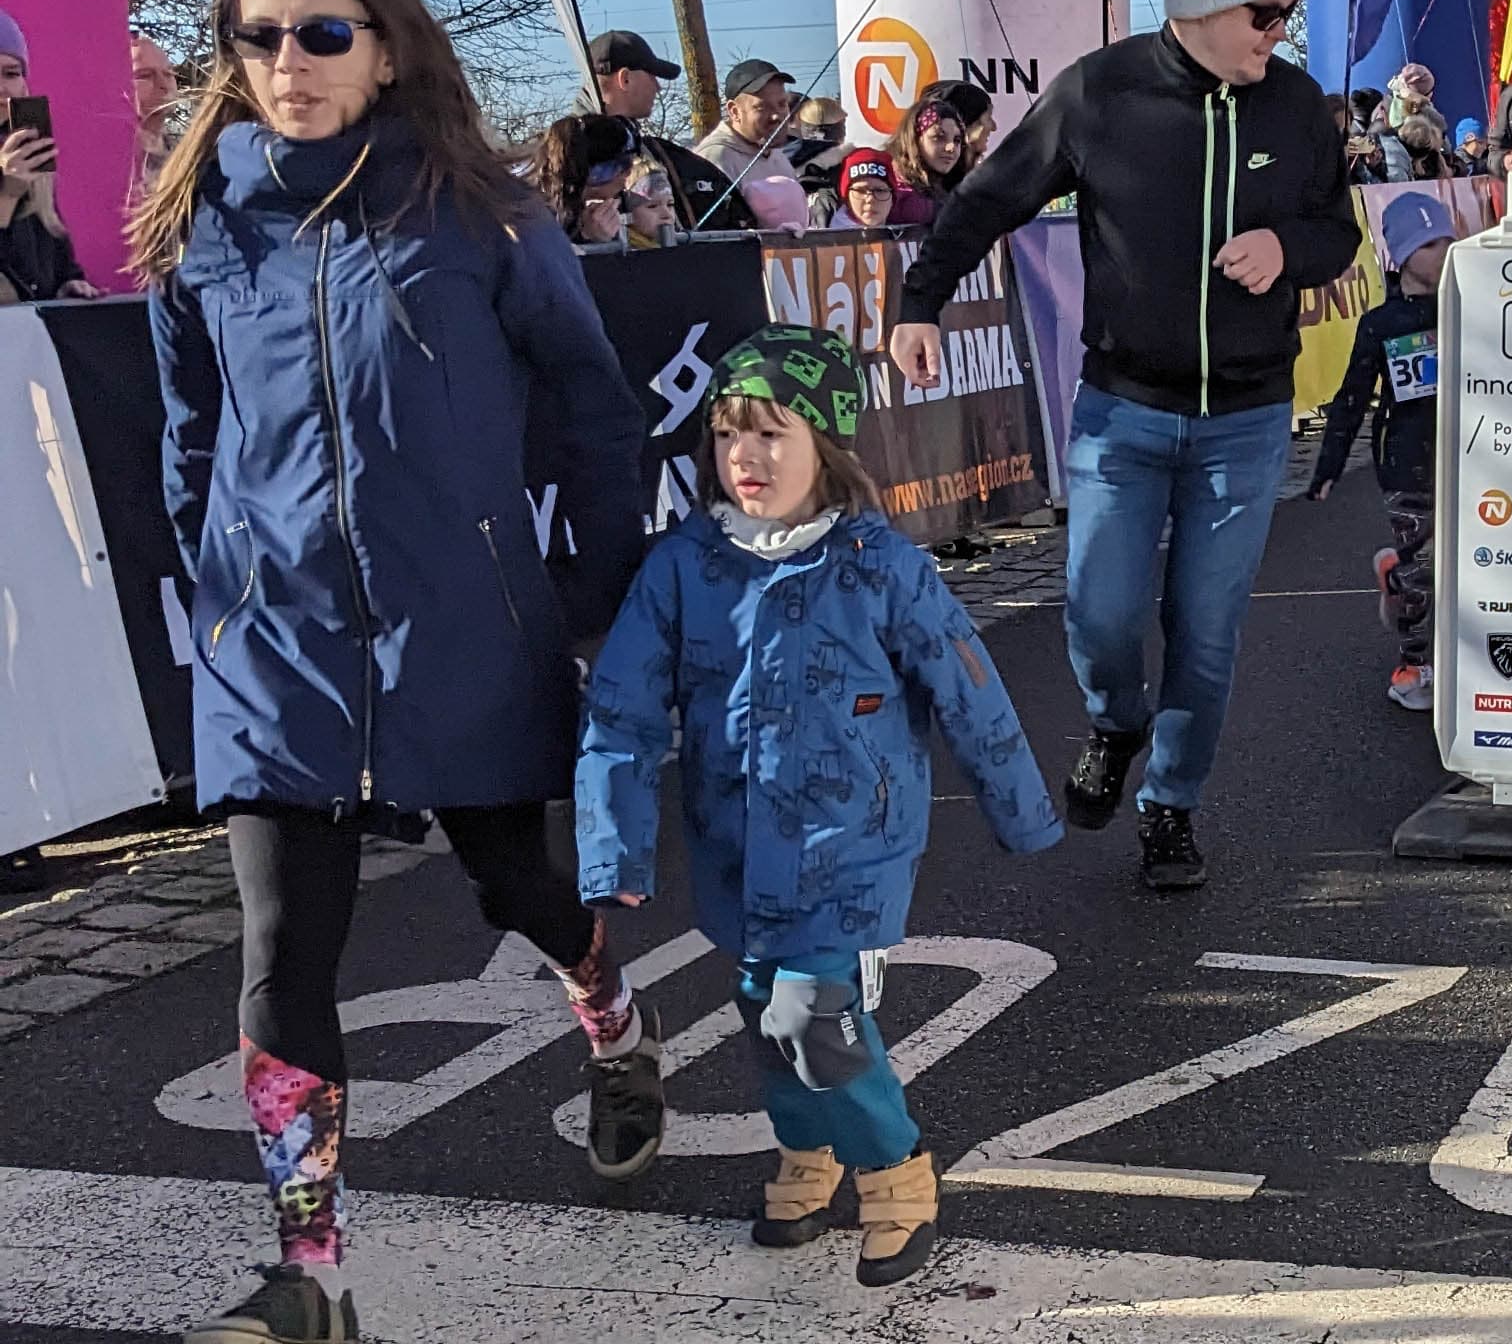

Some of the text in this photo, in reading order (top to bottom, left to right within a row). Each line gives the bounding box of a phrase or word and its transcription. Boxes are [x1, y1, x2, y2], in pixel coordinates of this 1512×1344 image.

[959, 58, 1040, 94] NN
[850, 163, 887, 178] BOSS
[1493, 439, 1511, 454] by
